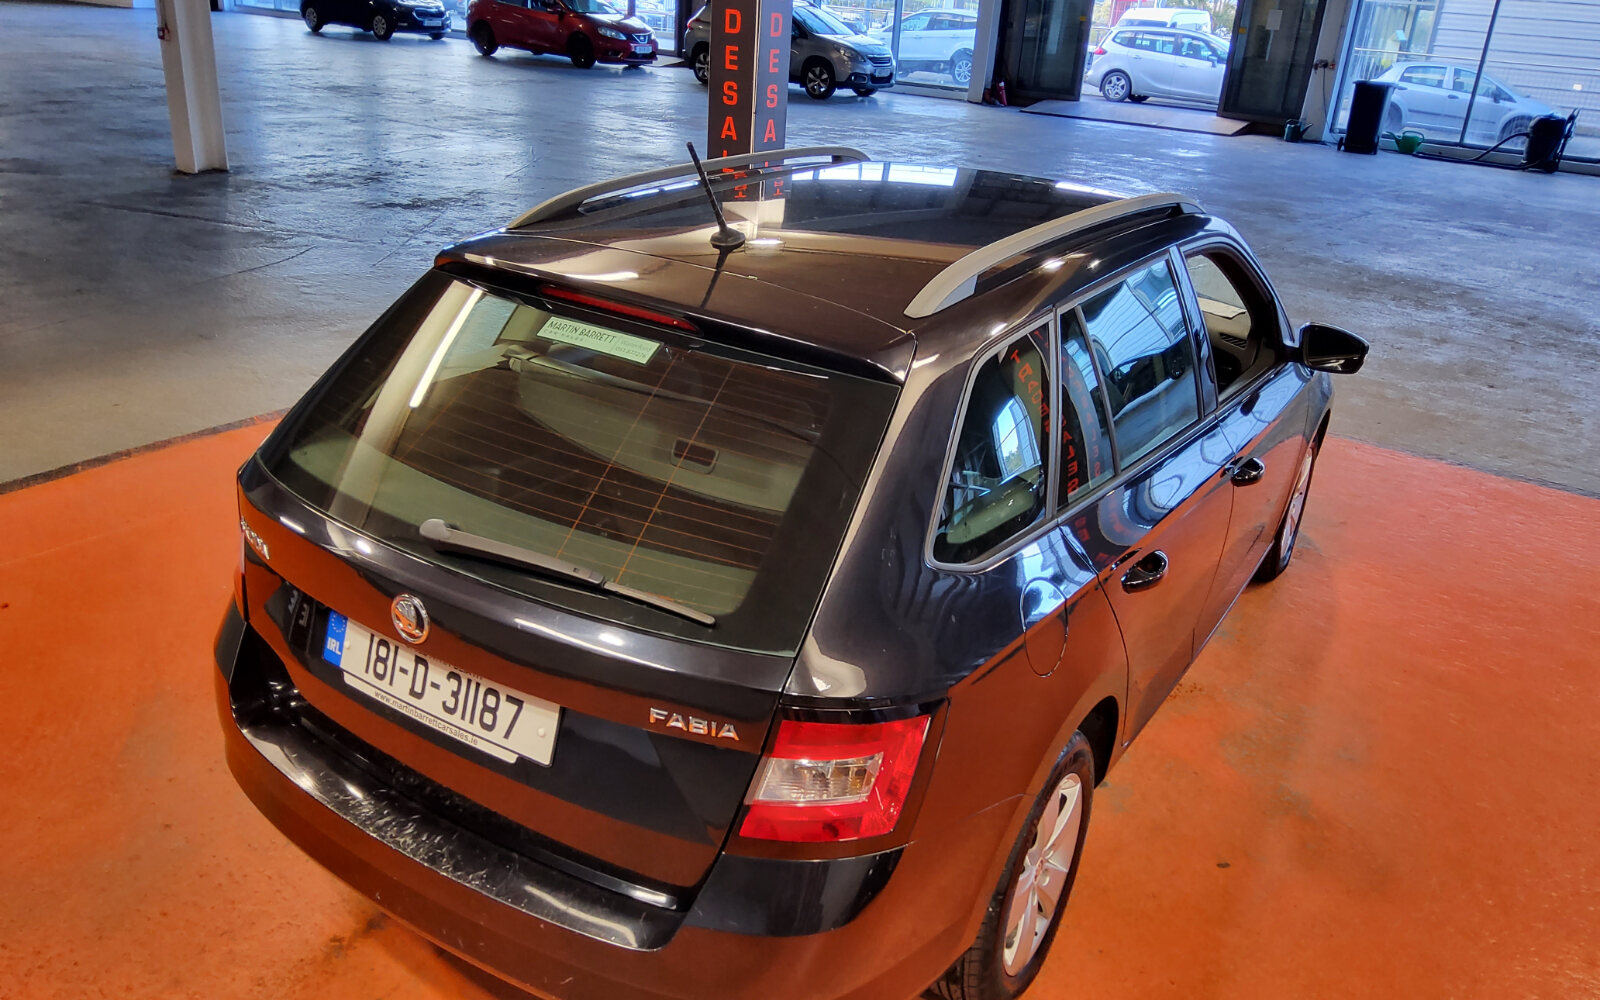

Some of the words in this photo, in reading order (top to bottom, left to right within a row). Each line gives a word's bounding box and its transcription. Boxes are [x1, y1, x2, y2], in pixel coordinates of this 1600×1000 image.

[547, 320, 580, 335] MARTIN
[578, 328, 617, 344] BARRETT
[327, 637, 341, 655] IRL
[365, 633, 525, 740] 181-D-31187
[374, 690, 479, 745] www.martinbarrettcarsales.ie
[649, 707, 740, 741] FABIA
